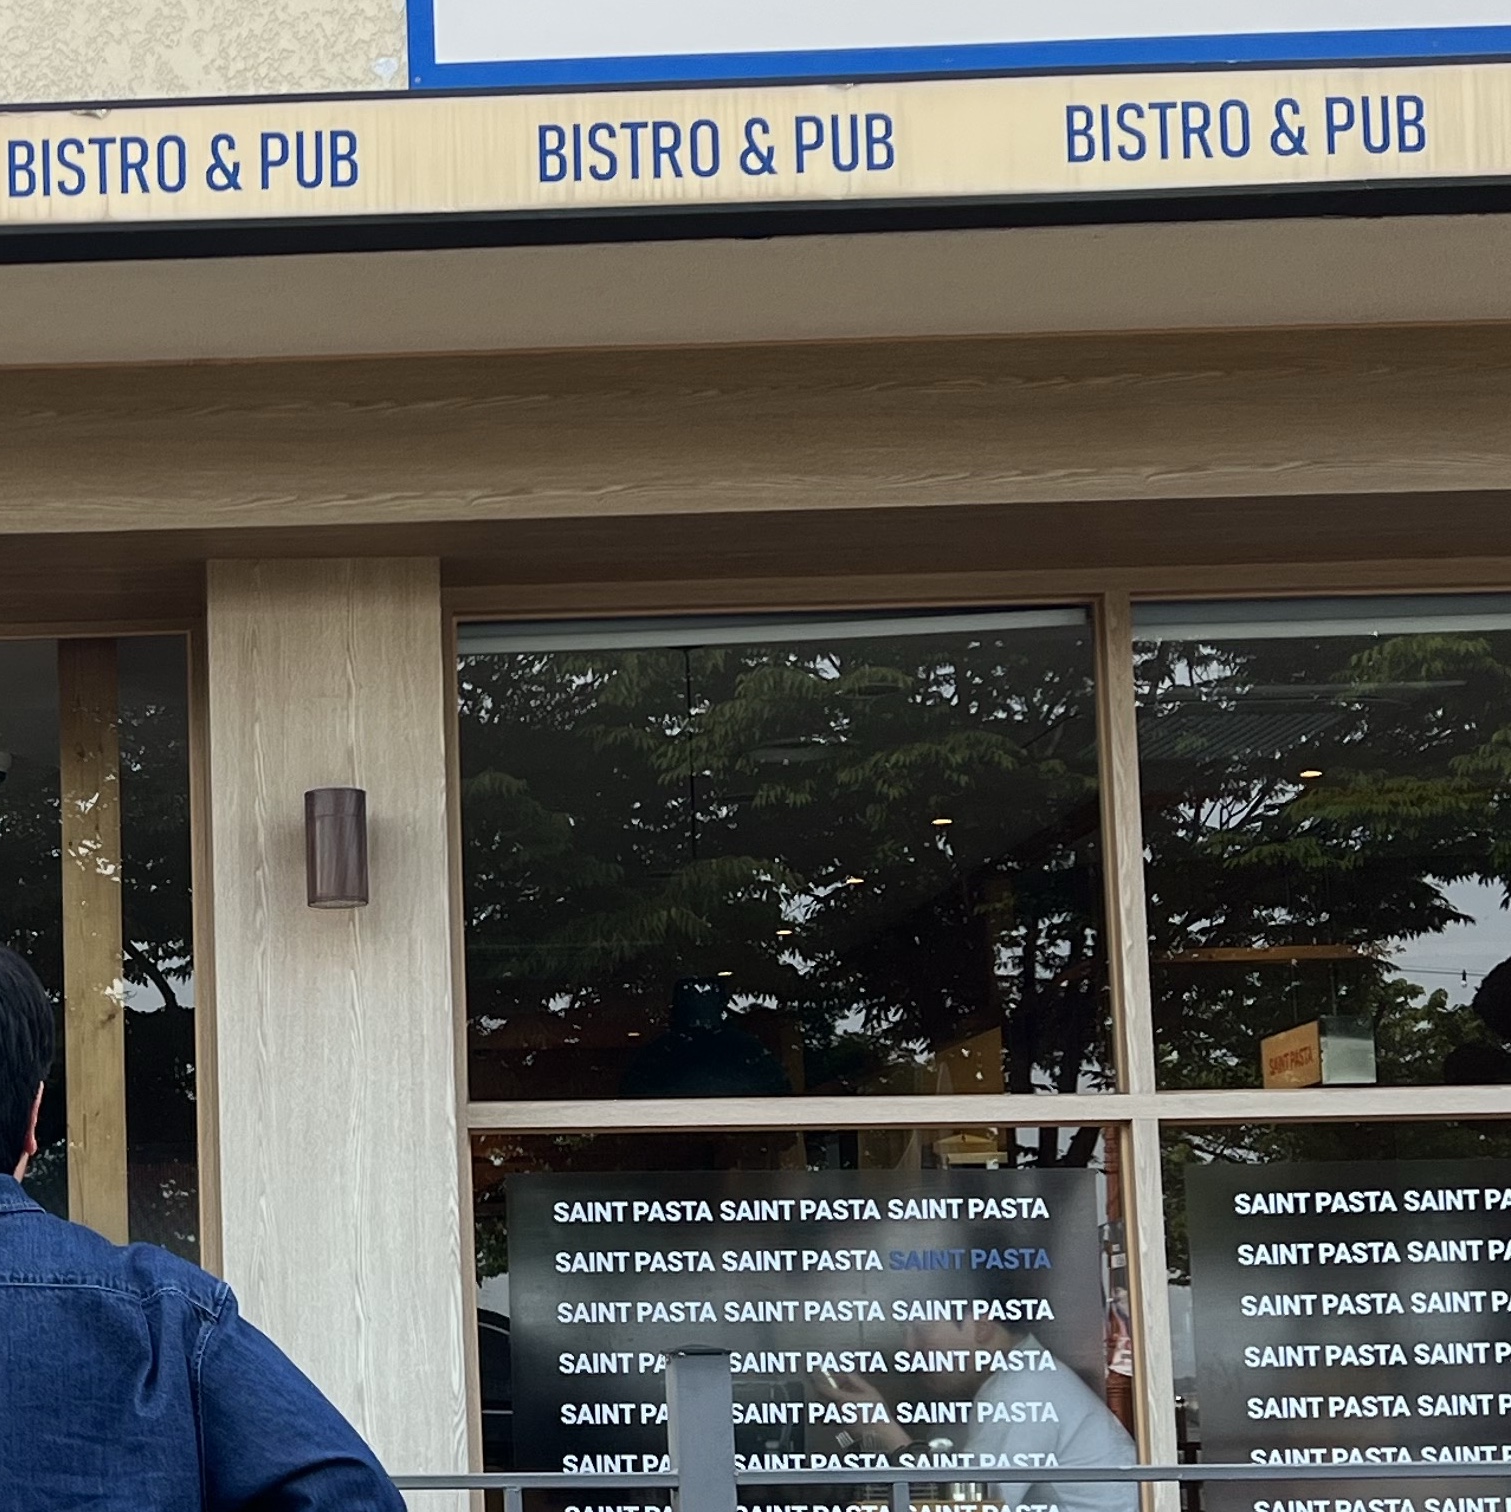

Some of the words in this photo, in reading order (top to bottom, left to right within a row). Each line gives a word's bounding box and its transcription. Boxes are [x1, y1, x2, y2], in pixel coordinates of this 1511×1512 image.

[1065, 99, 1249, 163] BISTRO
[1269, 97, 1308, 157] &
[1325, 94, 1428, 156] PUB
[538, 119, 720, 183] BISTRO
[738, 117, 777, 177] &
[793, 113, 895, 173] PUB
[7, 135, 187, 198] BISTRO
[205, 132, 242, 192] &
[260, 129, 360, 190] PUB
[553, 1201, 628, 1223] SAINT
[633, 1200, 713, 1222] PASTA
[720, 1200, 795, 1221] SAINT
[800, 1199, 881, 1221] PASTA
[888, 1198, 963, 1220] SAINT
[968, 1197, 1050, 1219] PASTA
[1234, 1192, 1310, 1215] SAINT
[1315, 1191, 1398, 1214] PASTA
[1404, 1189, 1480, 1212] SAINT
[555, 1251, 630, 1273] SAINT
[635, 1251, 716, 1272] PASTA
[722, 1250, 797, 1272] SAINT
[802, 1250, 883, 1271] PASTA
[890, 1249, 964, 1271] SAINT
[970, 1248, 1052, 1270] PASTA
[1237, 1243, 1314, 1266] SAINT
[1319, 1242, 1401, 1265] PASTA
[1407, 1240, 1483, 1263] SAINT
[557, 1302, 631, 1324] SAINT
[637, 1302, 717, 1323] PASTA
[724, 1301, 799, 1323] SAINT
[805, 1301, 885, 1322] PASTA
[892, 1300, 968, 1322] SAINT
[973, 1299, 1055, 1321] PASTA
[1240, 1294, 1317, 1317] SAINT
[1322, 1293, 1404, 1316] PASTA
[1410, 1291, 1486, 1314] SAINT
[559, 1353, 634, 1375] SAINT
[730, 1352, 801, 1374] SAINT
[806, 1351, 888, 1373] PASTA
[894, 1350, 970, 1373] SAINT
[975, 1350, 1057, 1372] PASTA
[1244, 1345, 1320, 1368] SAINT
[1325, 1344, 1407, 1367] PASTA
[1414, 1342, 1490, 1365] SAINT
[560, 1403, 635, 1425] SAINT
[732, 1402, 804, 1424] SAINT
[808, 1402, 890, 1424] PASTA
[896, 1401, 972, 1424] SAINT
[977, 1401, 1059, 1423] PASTA
[1247, 1397, 1323, 1420] SAINT
[1328, 1395, 1411, 1418] PASTA
[1417, 1394, 1493, 1417] SAINT
[562, 1454, 637, 1473] SAINT
[1250, 1448, 1327, 1464] SAINT
[1332, 1447, 1412, 1463] PASTA
[1421, 1446, 1497, 1462] SAINT
